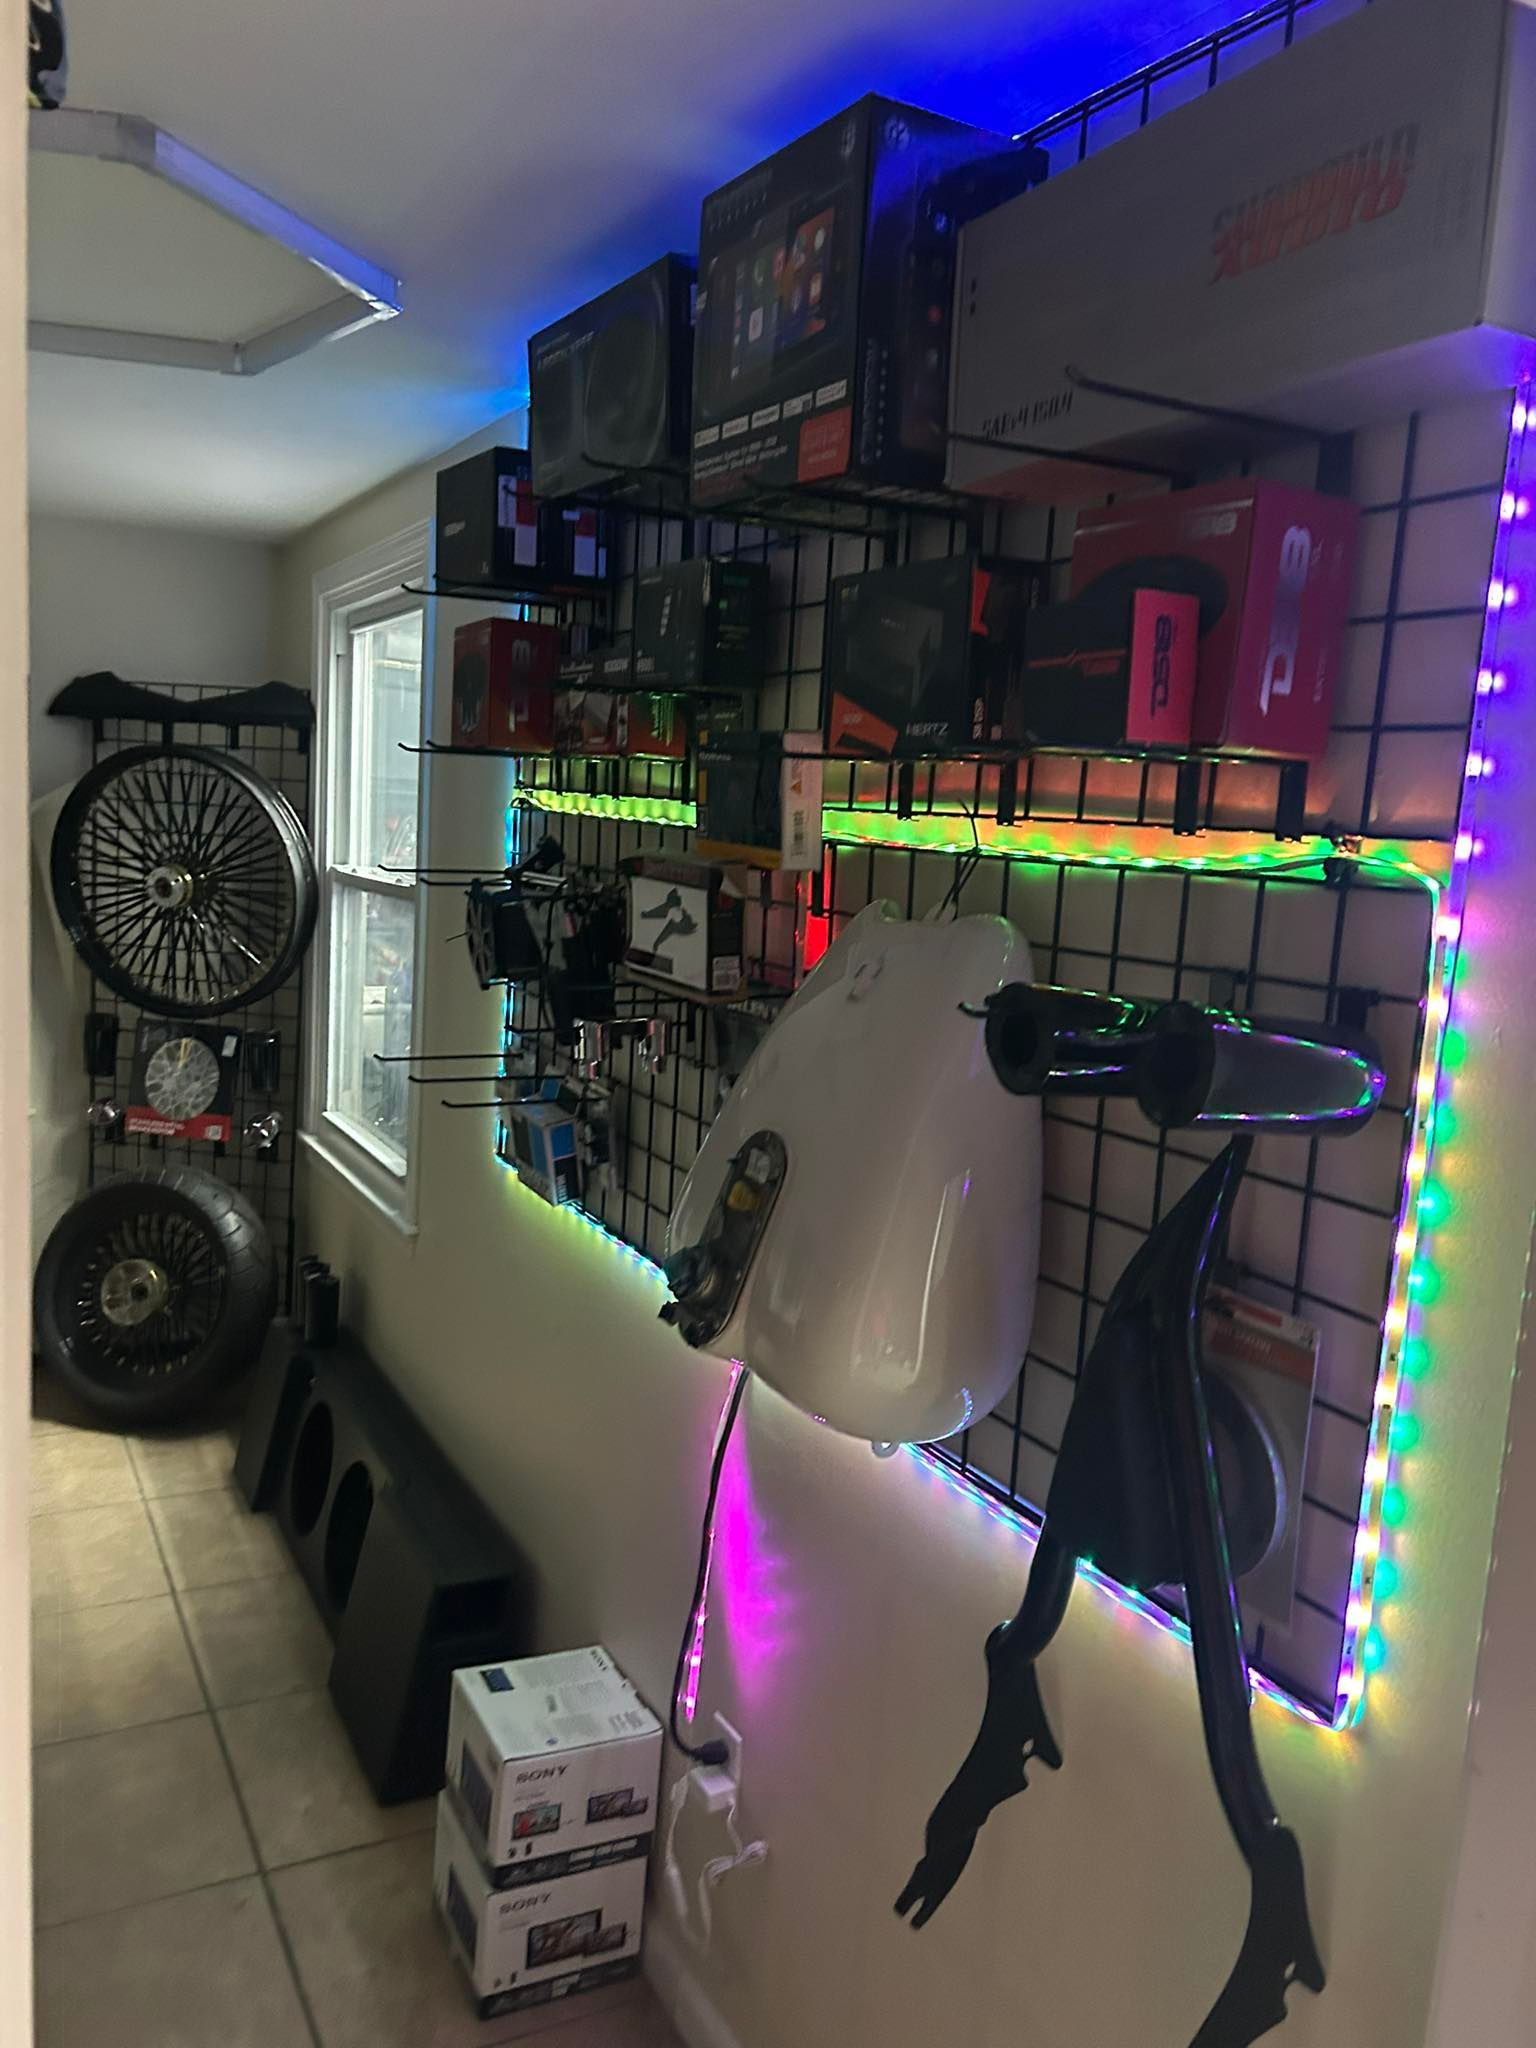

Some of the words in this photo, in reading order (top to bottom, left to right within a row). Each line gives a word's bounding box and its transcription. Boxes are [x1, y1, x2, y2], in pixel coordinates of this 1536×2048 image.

[1257, 524, 1312, 718] D8
[905, 721, 949, 737] HERTZ
[515, 1763, 569, 1785] SONY
[498, 1891, 553, 1914] SONY
